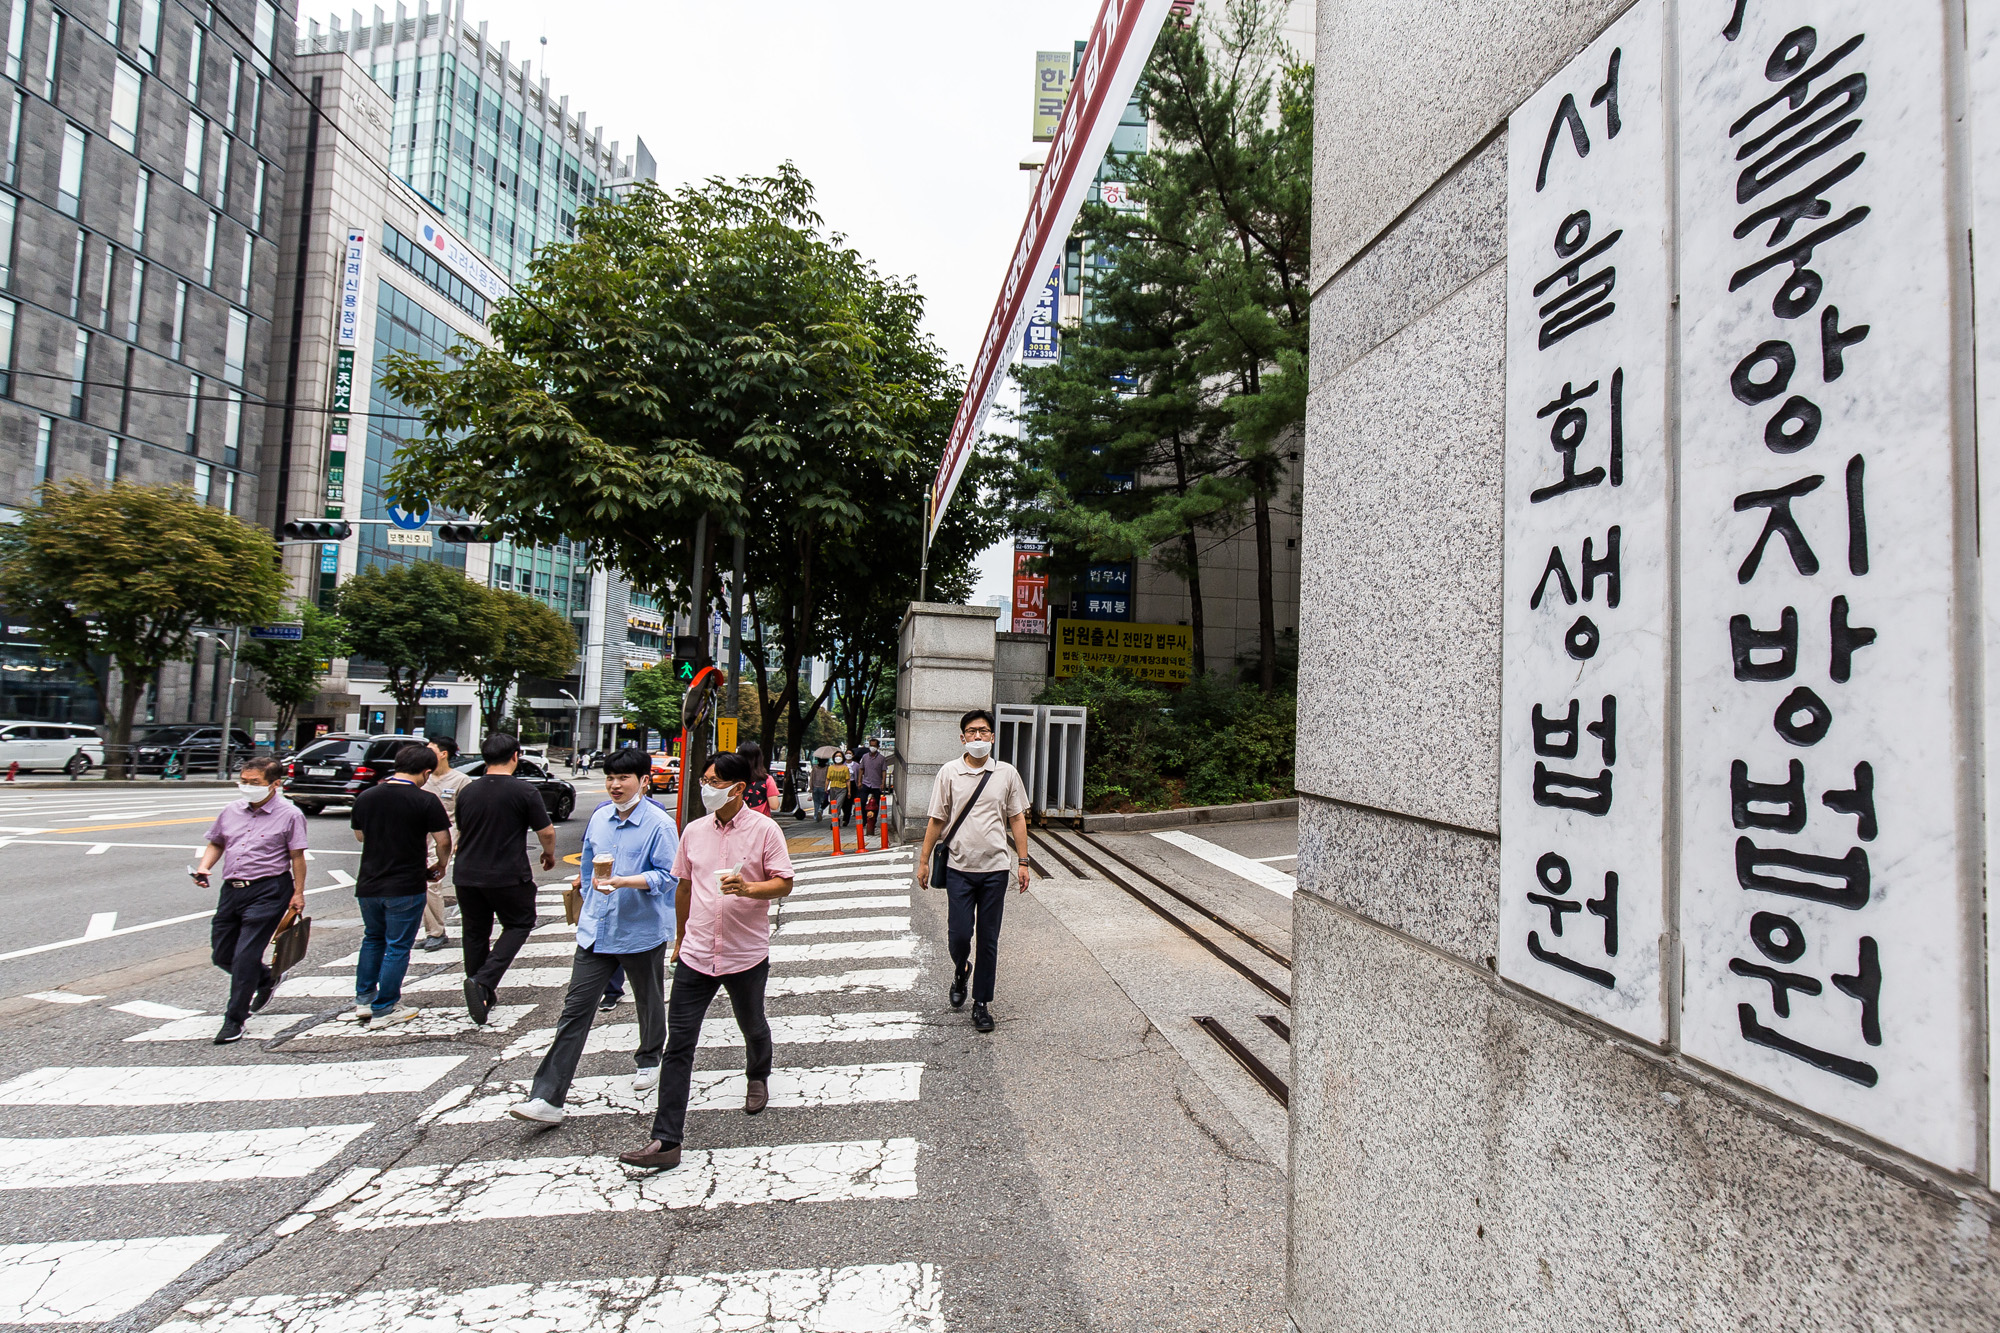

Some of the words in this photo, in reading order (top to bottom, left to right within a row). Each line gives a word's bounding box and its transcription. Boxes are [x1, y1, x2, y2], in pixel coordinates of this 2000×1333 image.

[1038, 67, 1067, 122] 한국
[447, 243, 506, 298] 고려신용정보
[341, 247, 361, 340] 고려신용정보
[334, 372, 351, 409] 天地人
[1527, 47, 1624, 989] 서울회생법원
[390, 534, 429, 543] 보행신호시
[1728, 0, 1882, 1088] 울중앙지방법원
[1090, 570, 1127, 584] 법무사
[1017, 585, 1045, 609] 민사
[1088, 600, 1126, 613] 류재봉
[1062, 626, 1119, 647] 법원출신
[1123, 632, 1153, 648] 전민갑
[1156, 634, 1187, 650] 법무사
[1062, 651, 1079, 661] 법원
